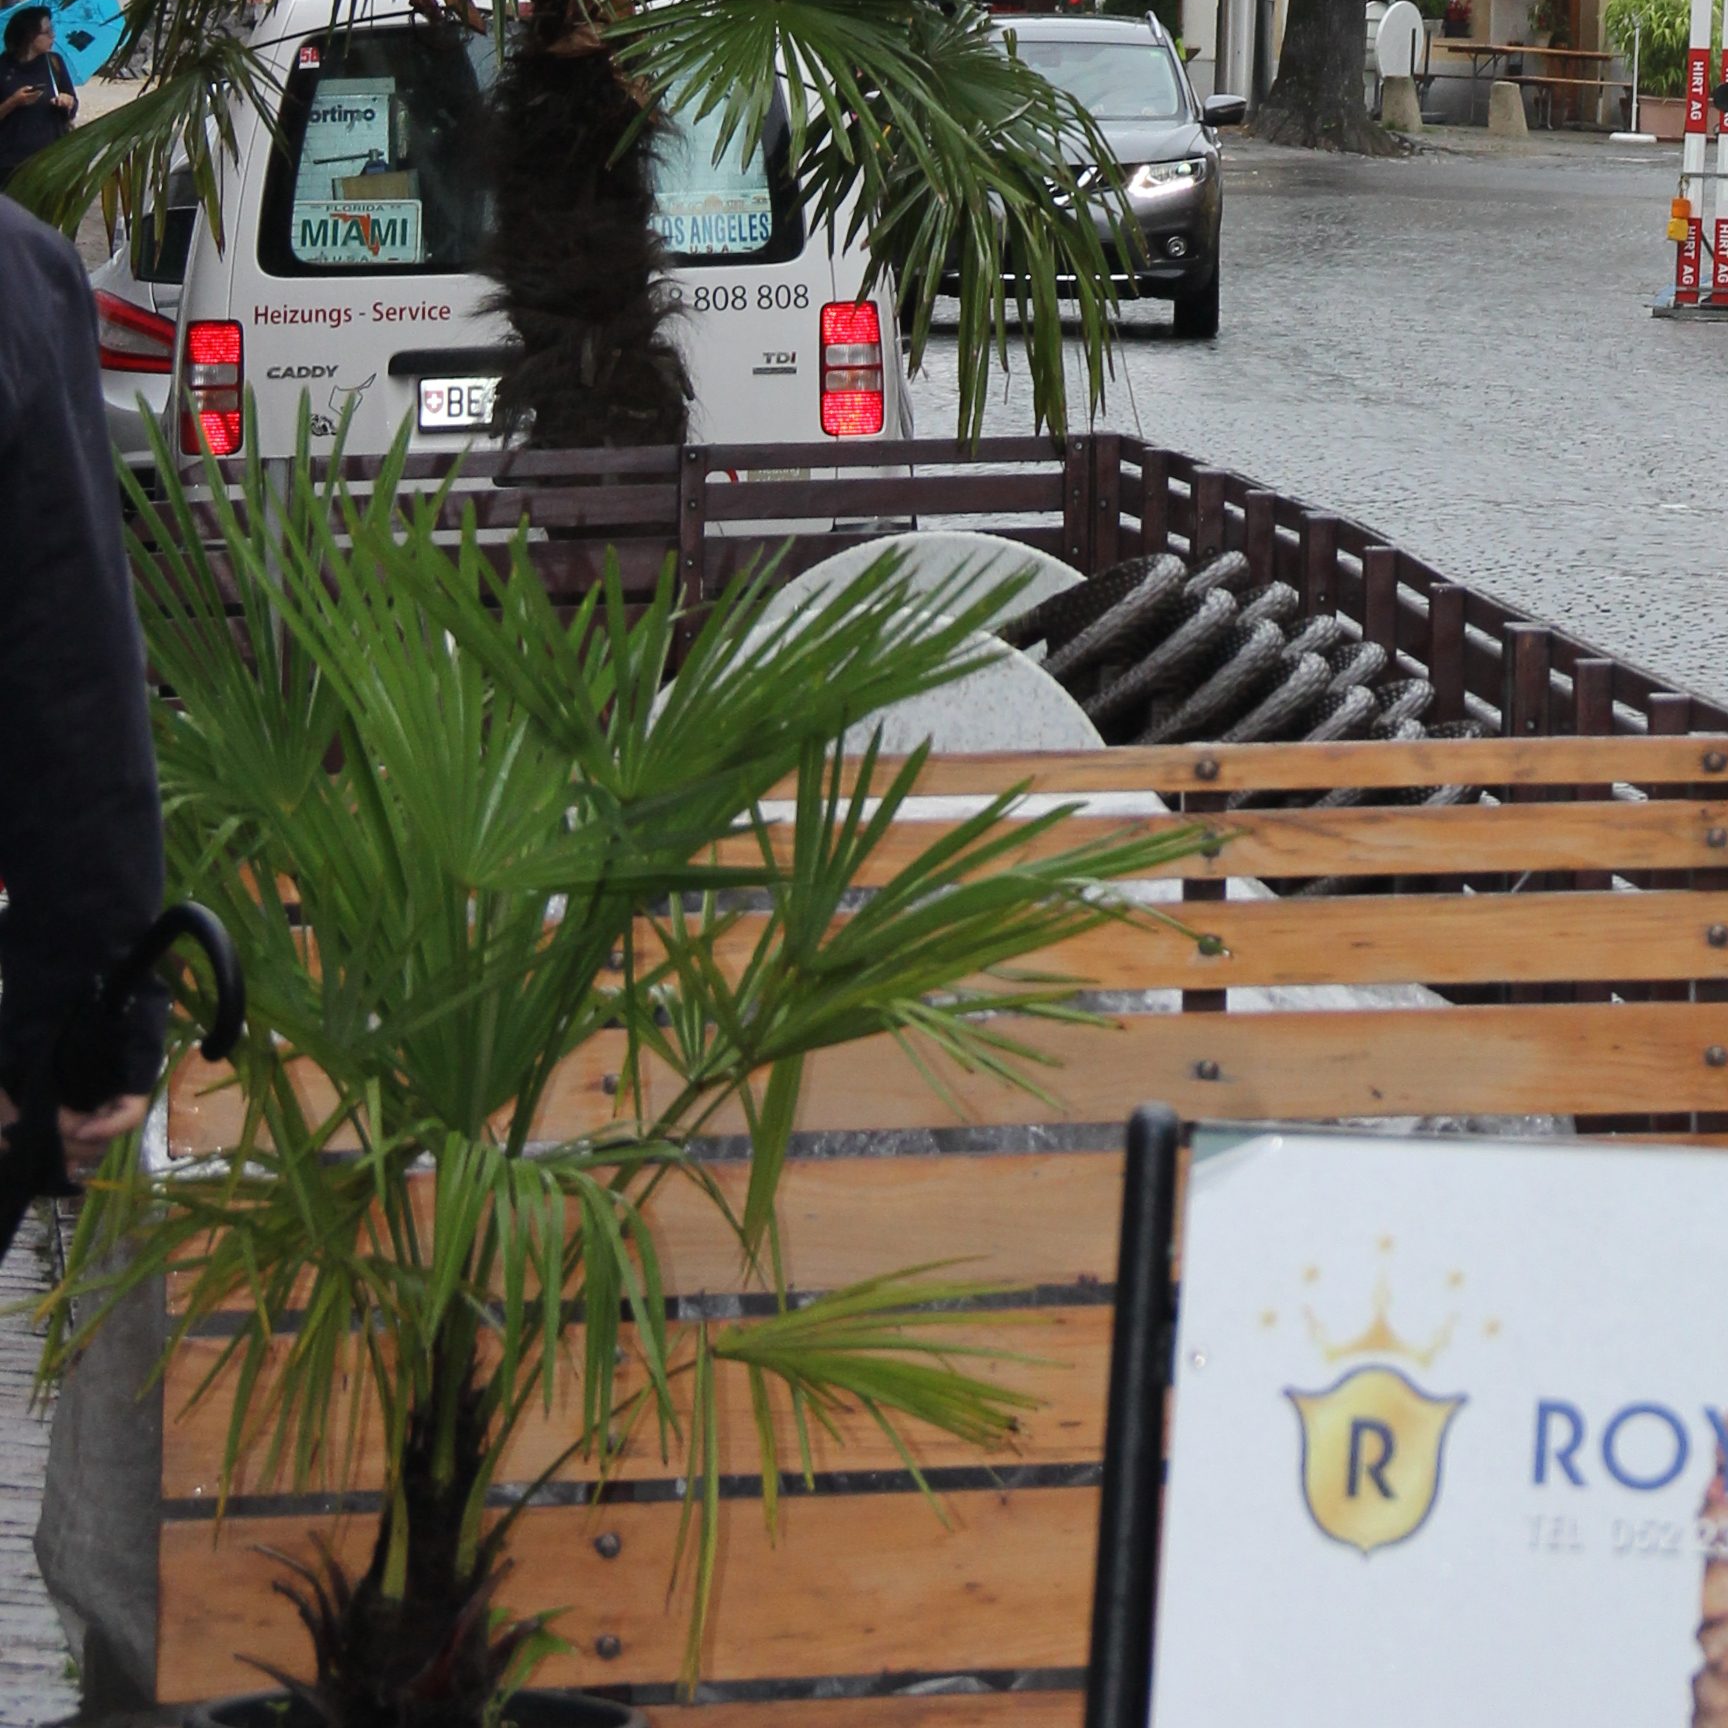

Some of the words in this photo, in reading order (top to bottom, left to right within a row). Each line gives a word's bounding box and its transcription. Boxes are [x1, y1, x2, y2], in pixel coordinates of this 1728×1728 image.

[1691, 60, 1704, 95] HIRT
[309, 104, 376, 123] ortimo
[1690, 103, 1702, 121] AG
[326, 204, 385, 213] FLORIDA
[301, 218, 408, 247] MIAMI
[690, 212, 769, 244] ANGELES
[1684, 225, 1697, 259] HIRT
[1682, 266, 1694, 285] AG
[1717, 266, 1728, 284] AG
[694, 285, 747, 312] 808
[757, 284, 809, 310] 808
[254, 304, 352, 328] Heizungs
[372, 301, 451, 322] Service
[763, 352, 796, 364] TDI
[266, 365, 339, 379] CADDY
[1347, 1418, 1396, 1498] R
